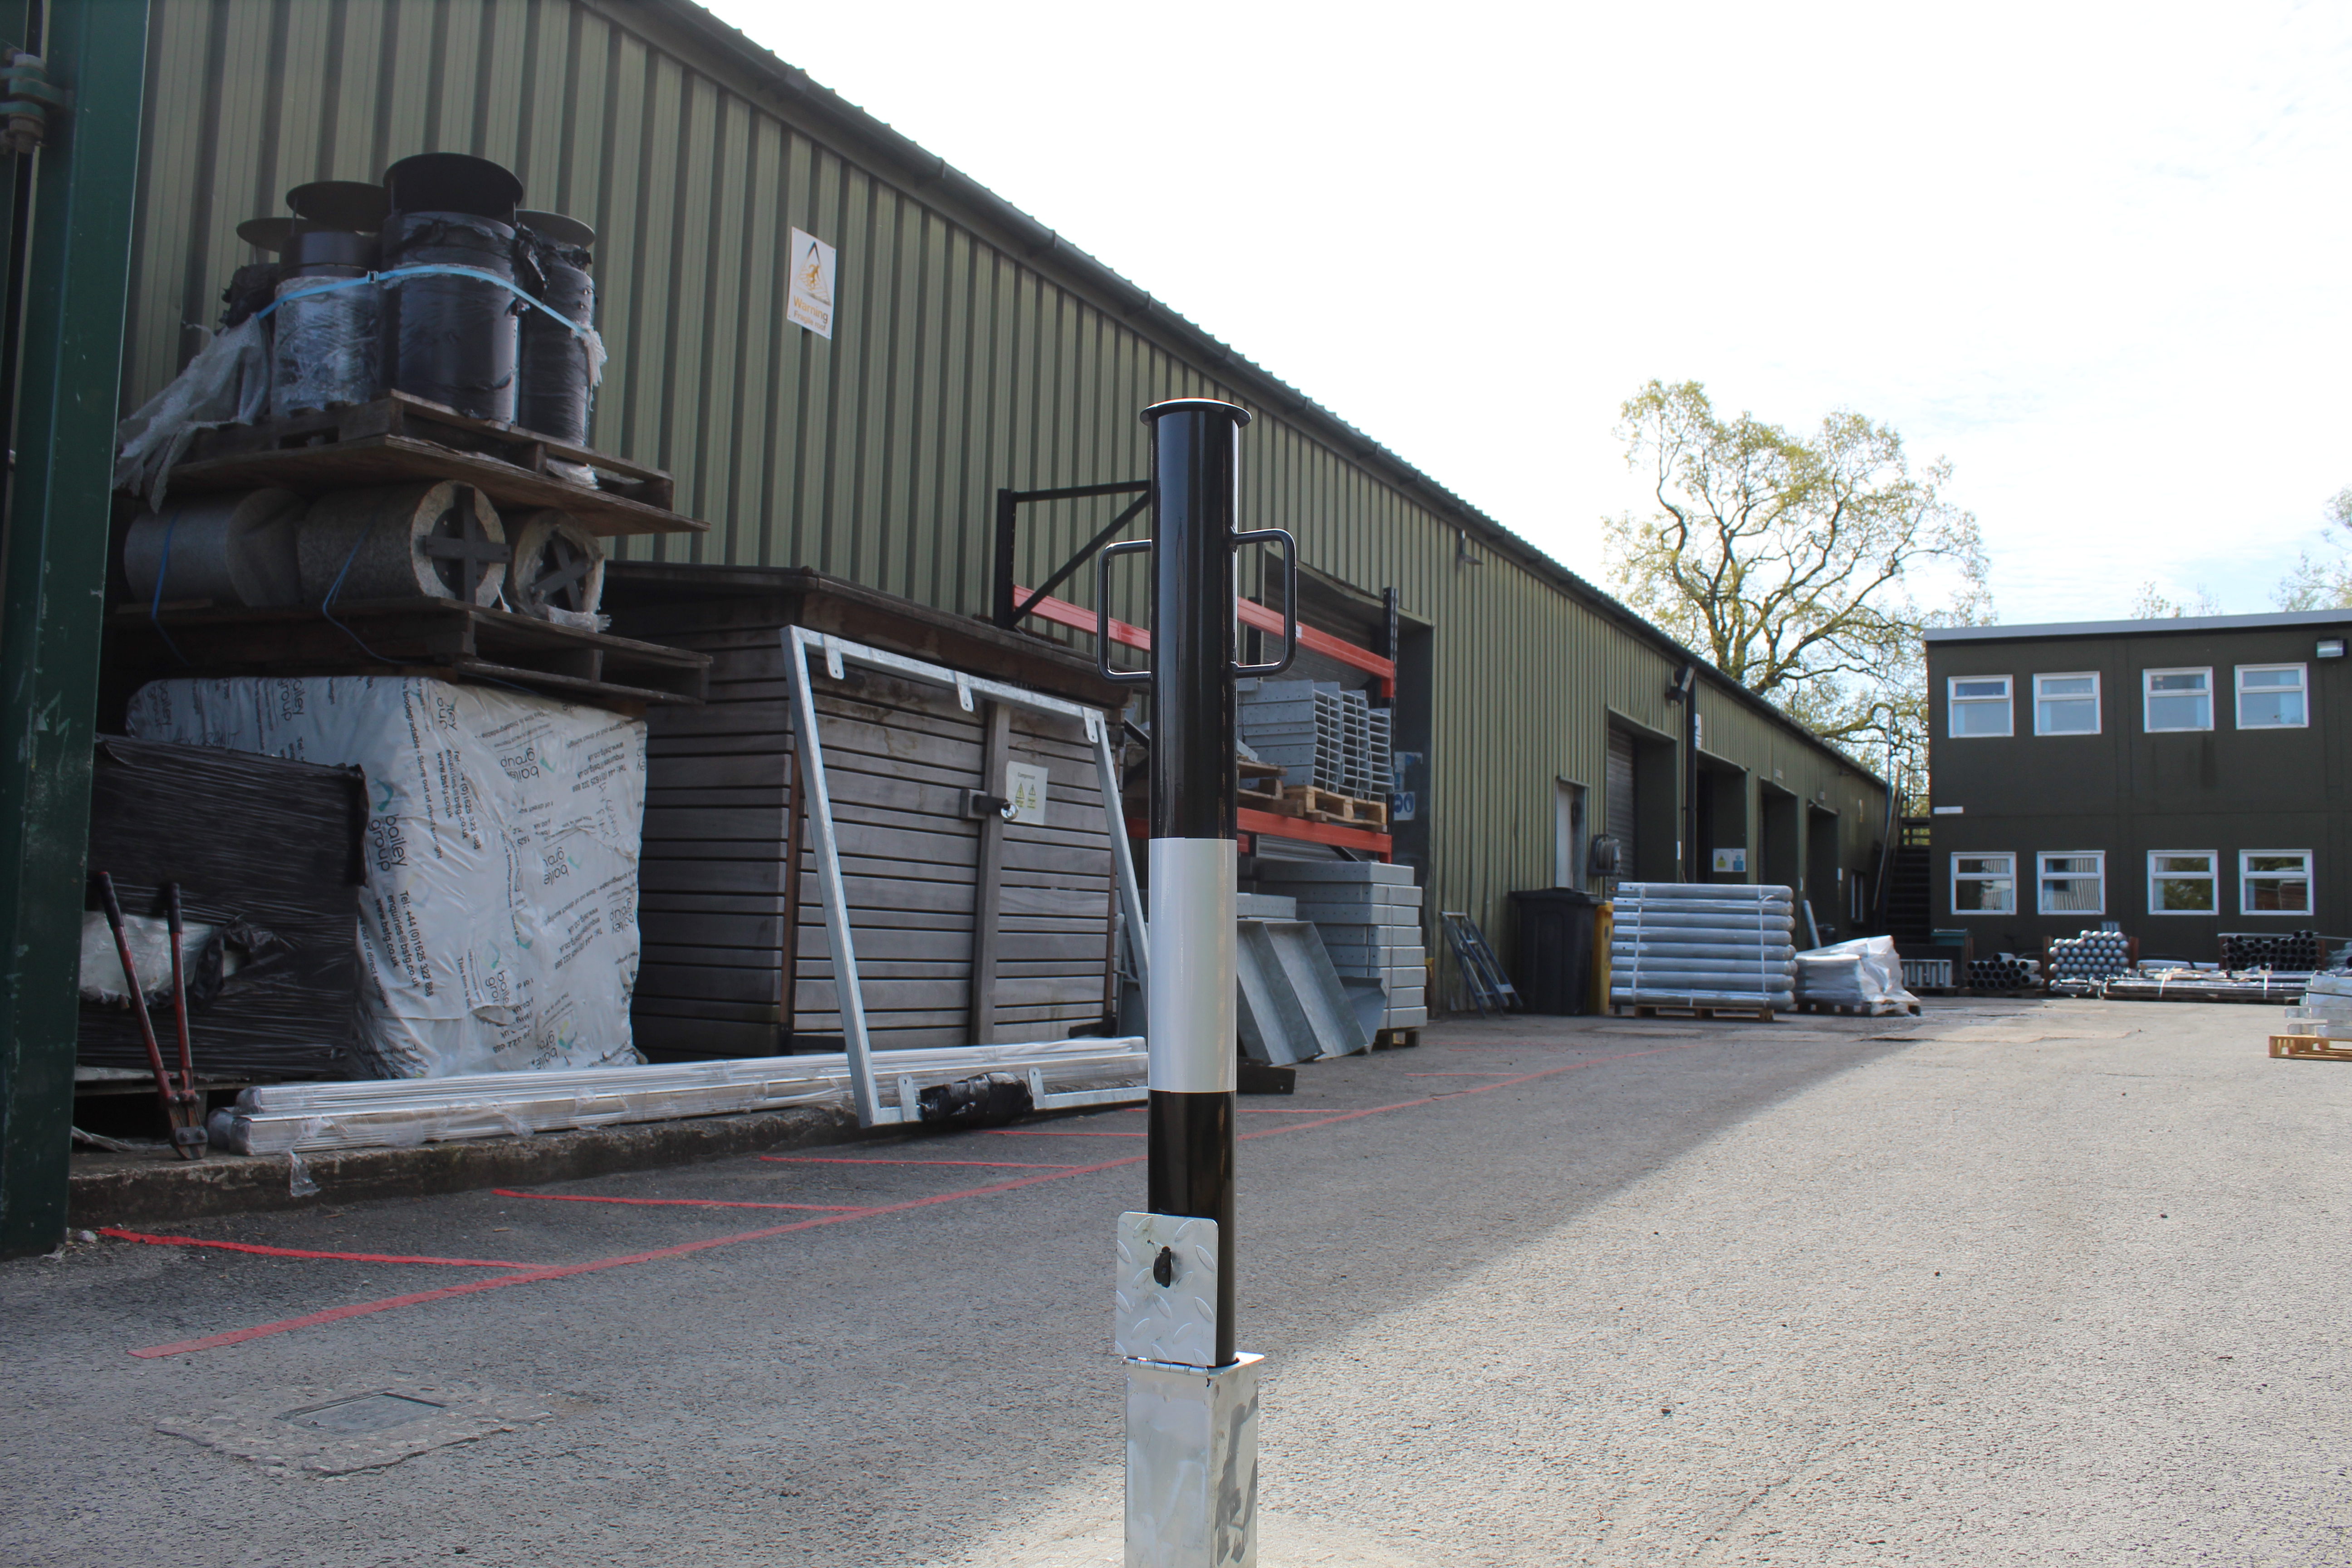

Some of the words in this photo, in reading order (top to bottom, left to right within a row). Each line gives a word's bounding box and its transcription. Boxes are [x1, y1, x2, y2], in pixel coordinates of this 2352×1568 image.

[794, 295, 828, 324] Warning
[794, 310, 813, 325] Fragile
[815, 322, 826, 331] roof
[293, 676, 305, 715] ailey
[402, 691, 420, 749] biodegradable
[417, 755, 426, 778] Store
[500, 747, 536, 768] group
[369, 818, 391, 872] group
[385, 814, 408, 866] bailey
[543, 846, 565, 867] gro
[544, 863, 569, 885] baile
[399, 889, 410, 908] Tel:
[407, 908, 417, 927] +44
[375, 898, 401, 968] www.bsfg.co.uk
[386, 894, 421, 988] enquiries@bsfg.co.uk
[408, 927, 427, 963] (0)1625
[366, 952, 378, 975] direct
[420, 963, 431, 980] 322
[424, 980, 435, 998] 888
[485, 976, 500, 1004] gro
[497, 970, 511, 1005] baile
[536, 1047, 559, 1070] baile
